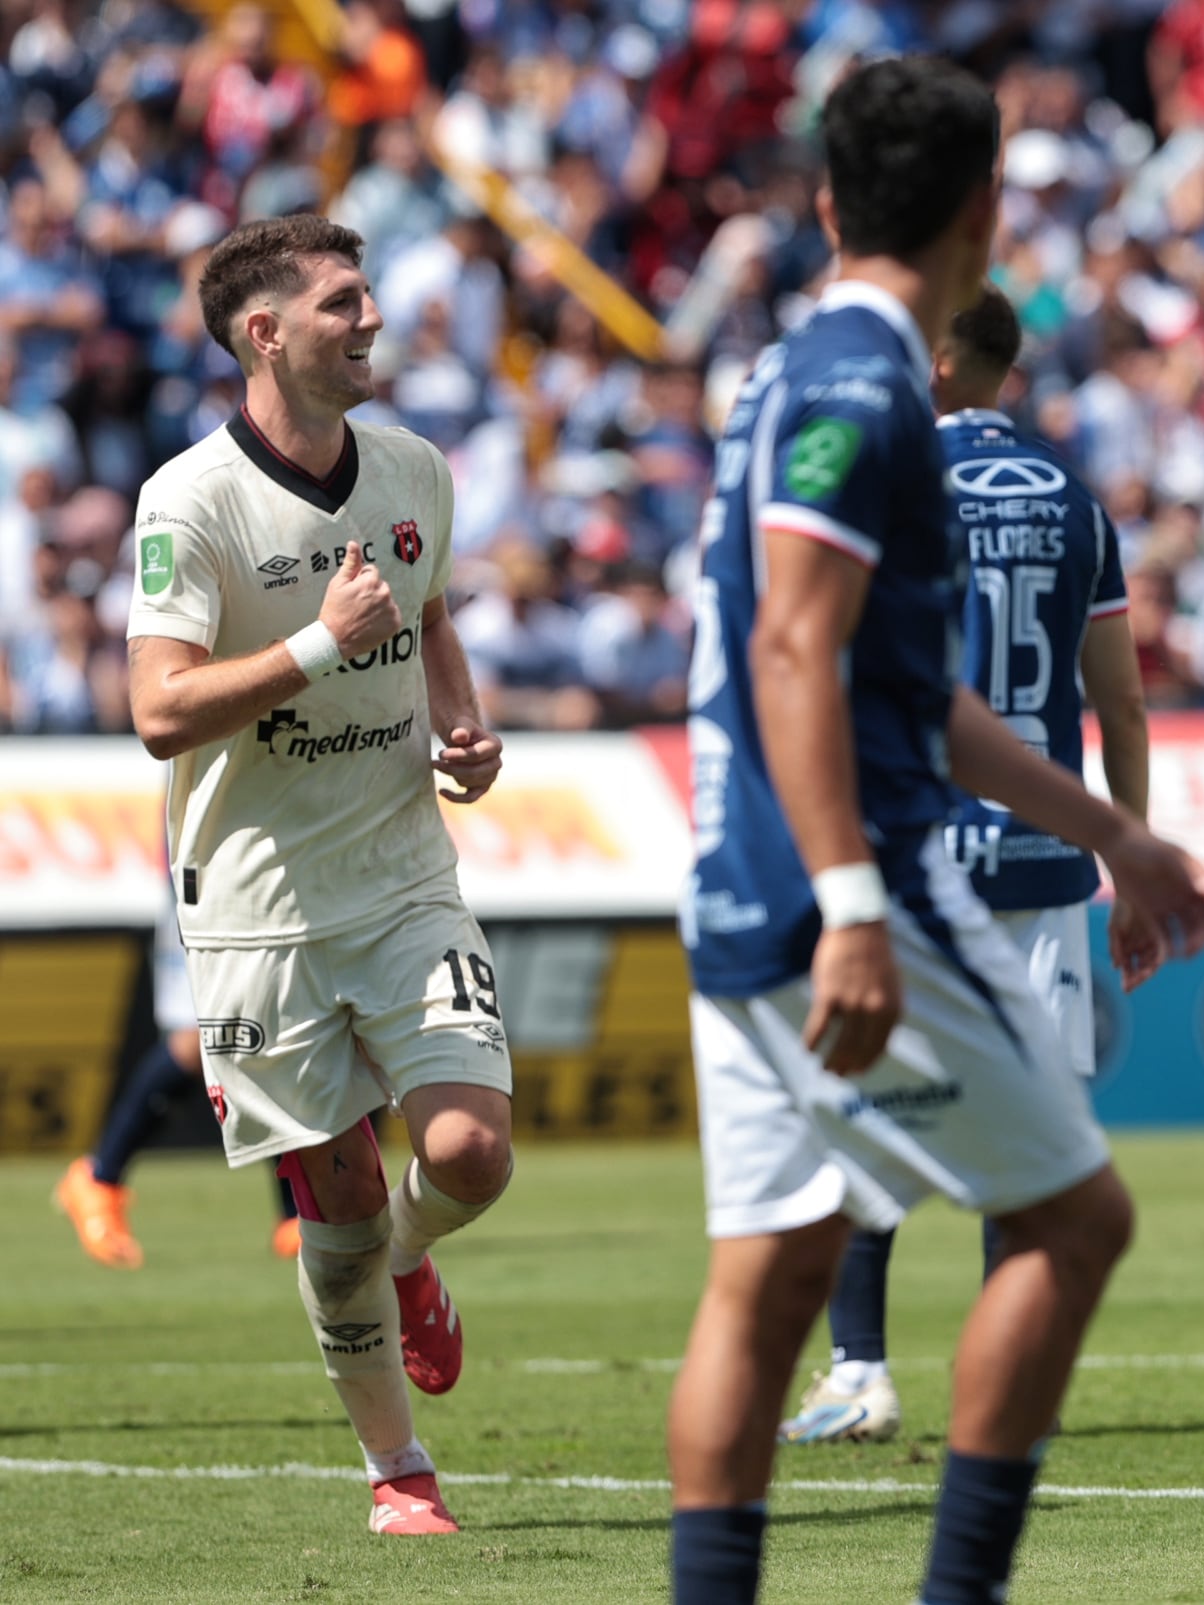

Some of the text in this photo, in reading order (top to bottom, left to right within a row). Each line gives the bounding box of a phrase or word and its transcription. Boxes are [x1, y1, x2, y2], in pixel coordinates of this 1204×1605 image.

[958, 499, 1070, 522] CHERY
[396, 524, 415, 534] LDA
[334, 542, 376, 567] BC
[968, 524, 1066, 562] FLORES
[264, 575, 299, 590] umbro
[974, 566, 1058, 713] 15
[287, 711, 414, 763] medismart
[443, 949, 501, 1020] 19
[201, 1024, 252, 1049] BUS
[322, 1337, 384, 1355] umbro
